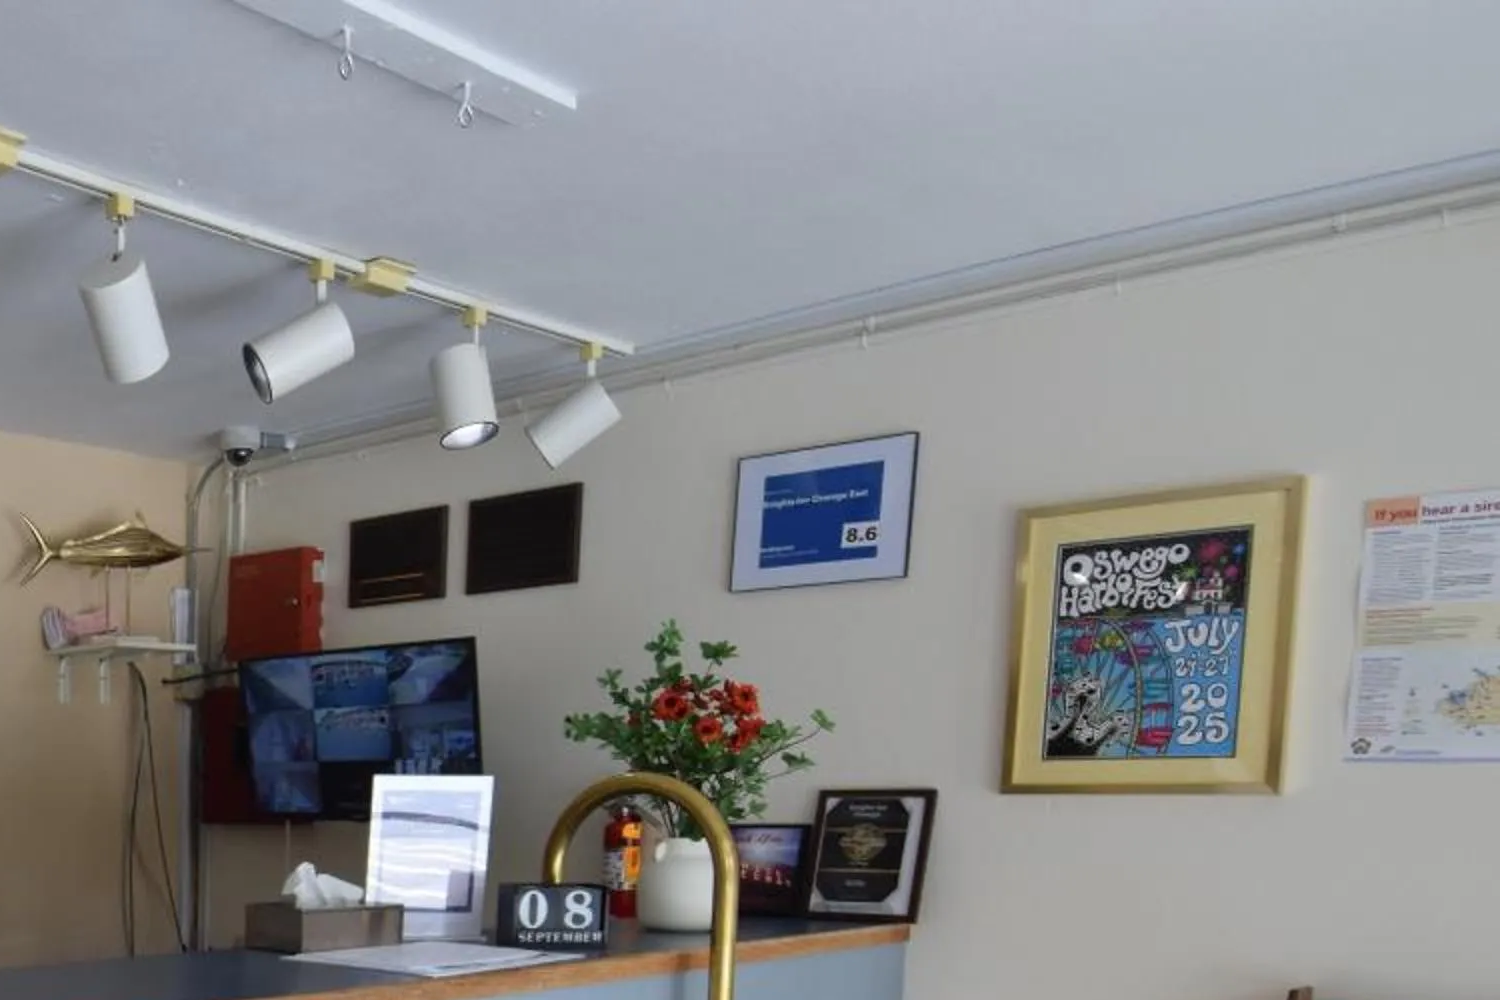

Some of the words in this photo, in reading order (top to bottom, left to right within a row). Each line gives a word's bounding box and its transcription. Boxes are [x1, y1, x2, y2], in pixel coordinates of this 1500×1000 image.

[1373, 508, 1387, 521] If
[1389, 507, 1418, 523] you
[1421, 504, 1456, 517] hear
[1460, 505, 1470, 513] a
[846, 526, 877, 543] 8.6
[1063, 543, 1190, 587] Oswego
[1180, 683, 1228, 713] 20
[1176, 711, 1230, 746] 25
[518, 931, 602, 943] SEPTEMBER
